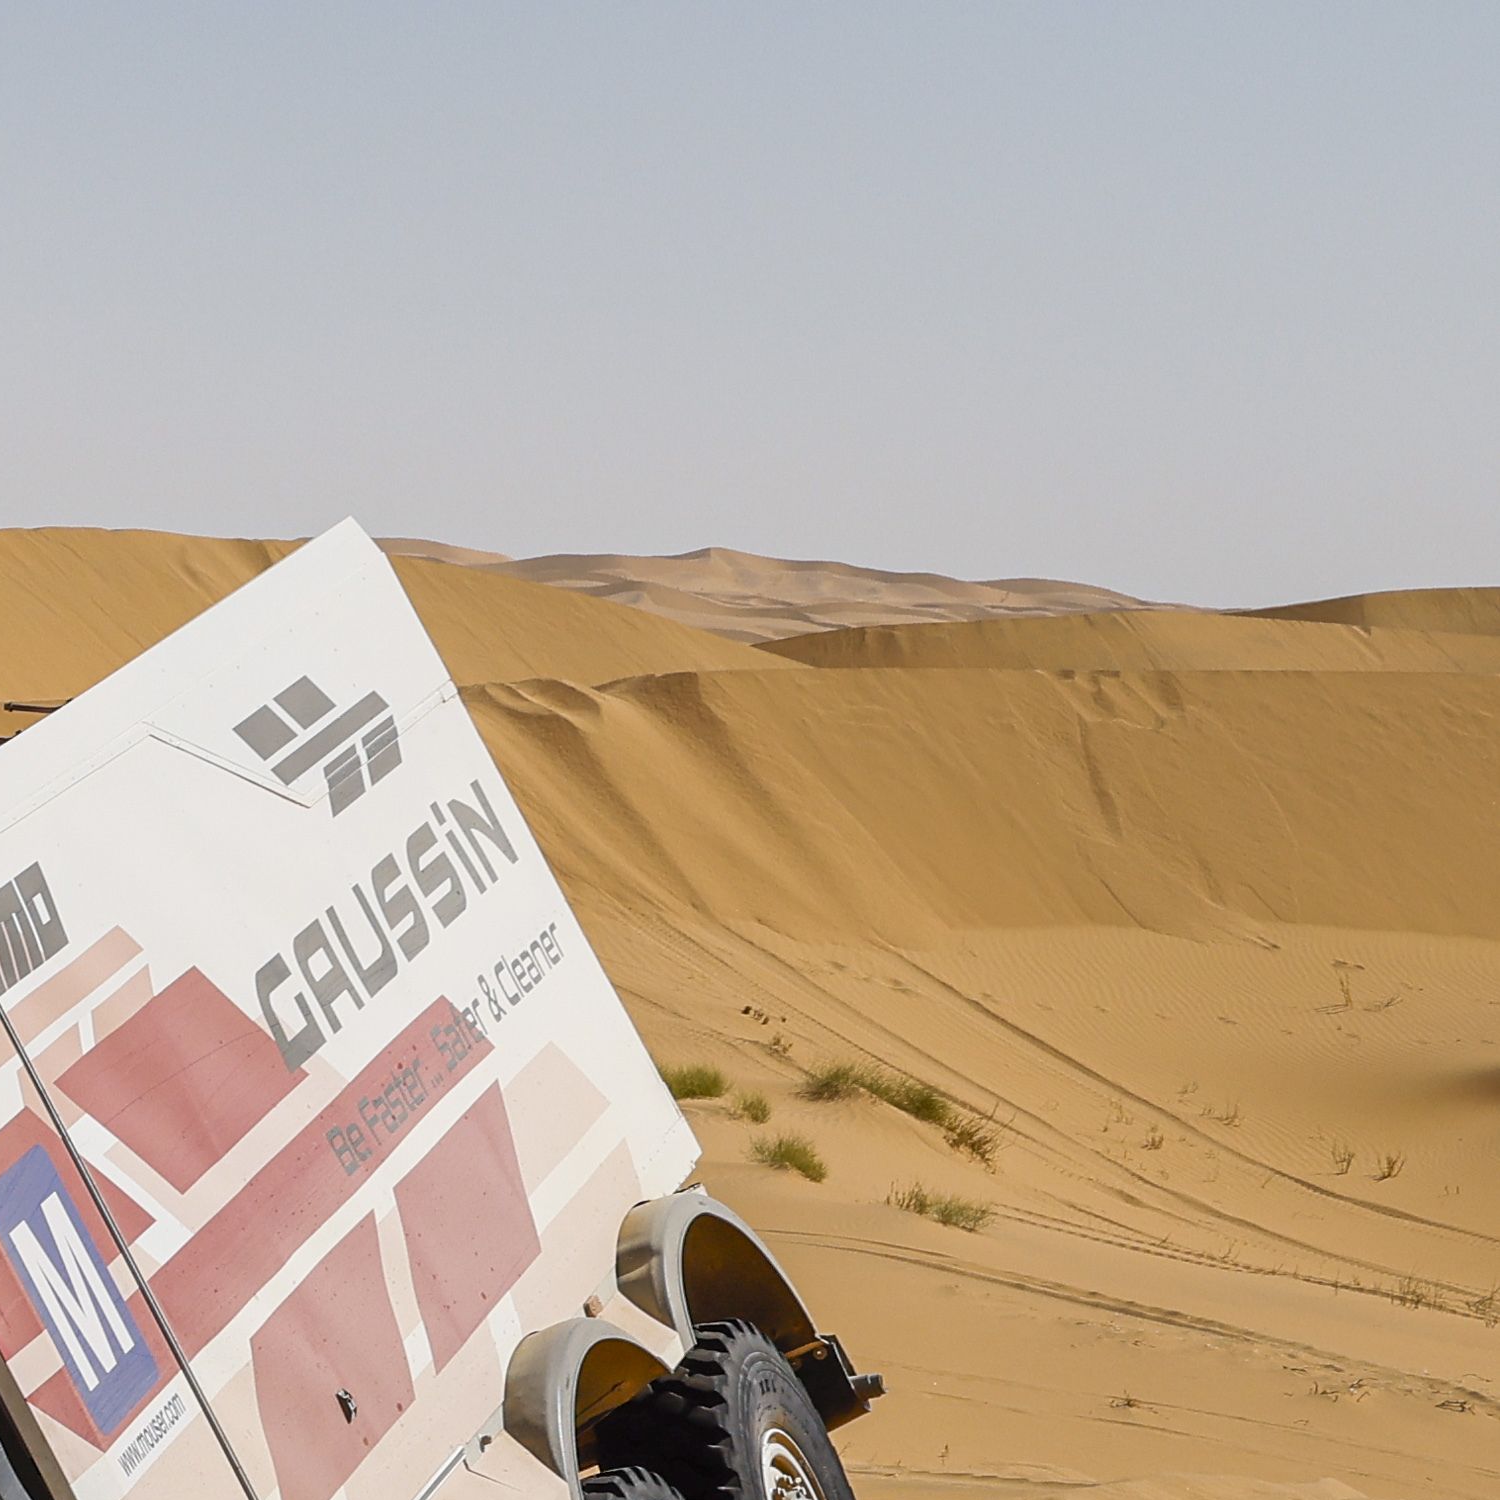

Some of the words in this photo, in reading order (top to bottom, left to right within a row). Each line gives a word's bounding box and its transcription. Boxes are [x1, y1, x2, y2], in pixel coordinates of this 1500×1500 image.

[325, 1122, 373, 1176] Be
[358, 1058, 429, 1146] Faster
[430, 1000, 488, 1073] Safer
[477, 974, 507, 1023] &
[494, 922, 564, 1007] Cleaner
[9, 1191, 135, 1392] M
[117, 1392, 187, 1477] www.mouser.com
